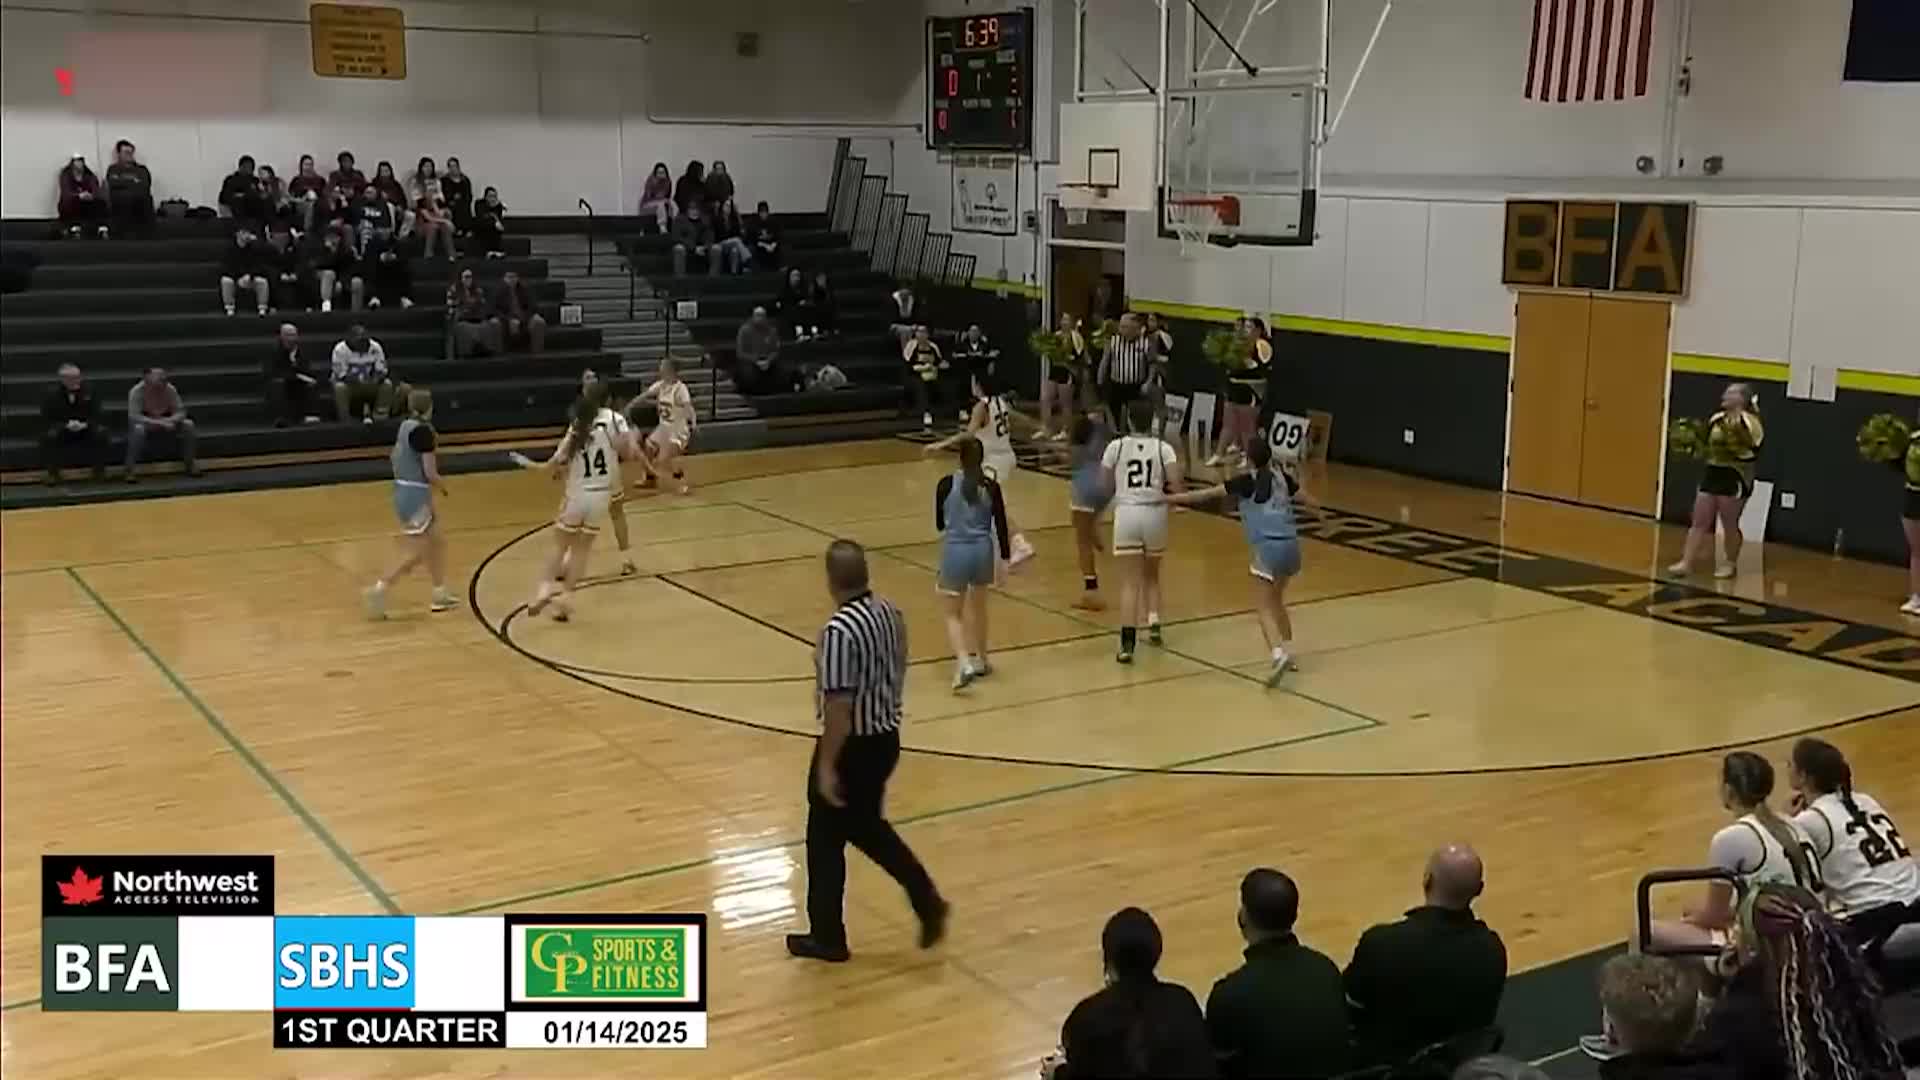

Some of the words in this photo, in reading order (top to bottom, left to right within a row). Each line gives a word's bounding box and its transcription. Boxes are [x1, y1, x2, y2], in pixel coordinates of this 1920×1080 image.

[1505, 203, 1682, 292] BFA
[582, 448, 608, 478] 14
[1127, 458, 1152, 488] 21
